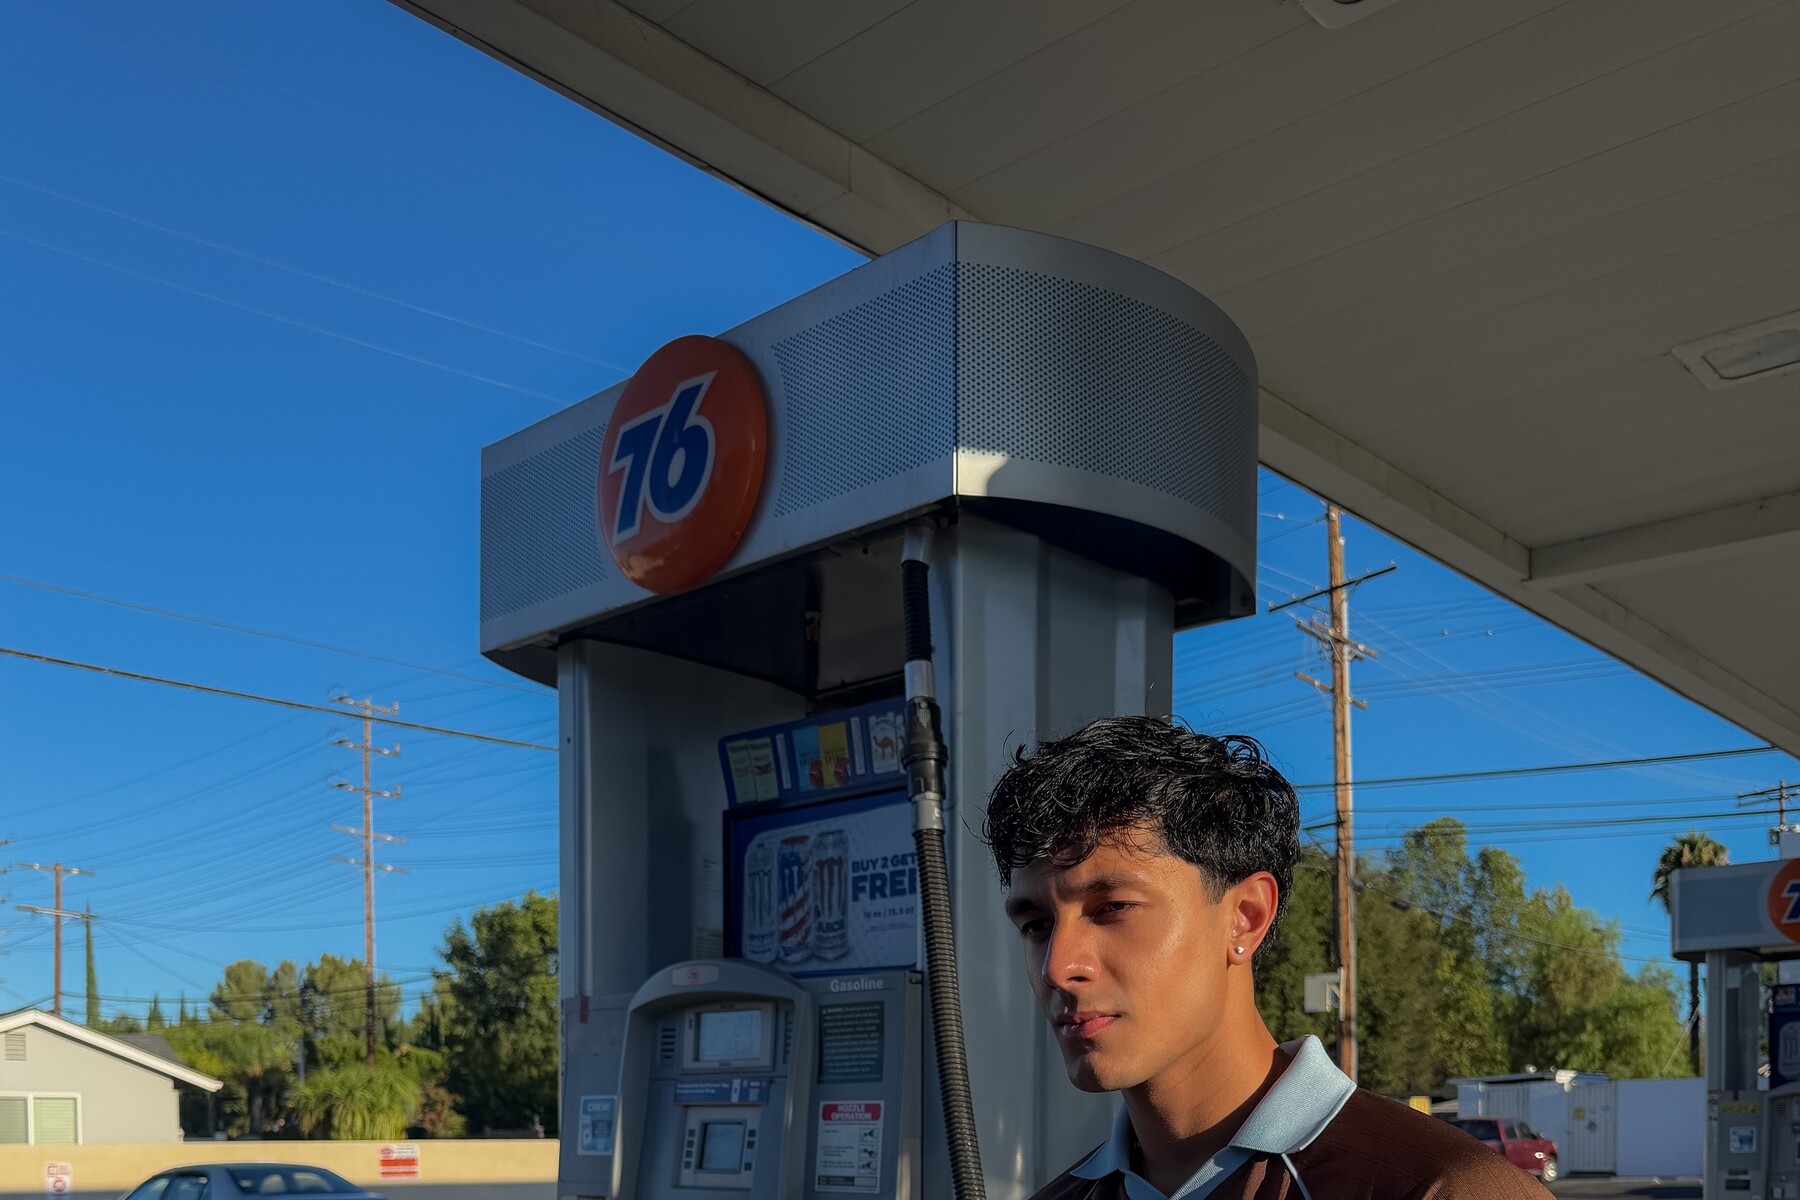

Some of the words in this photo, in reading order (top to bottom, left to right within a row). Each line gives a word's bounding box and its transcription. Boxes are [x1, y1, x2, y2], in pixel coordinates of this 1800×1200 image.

[608, 370, 718, 548] 76
[851, 857, 879, 874] BUY
[881, 856, 889, 869] 2
[890, 852, 918, 868] GET
[830, 978, 884, 992] Gasoline
[837, 1104, 866, 1113] NOZZLE
[830, 1112, 872, 1121] OPERATION
